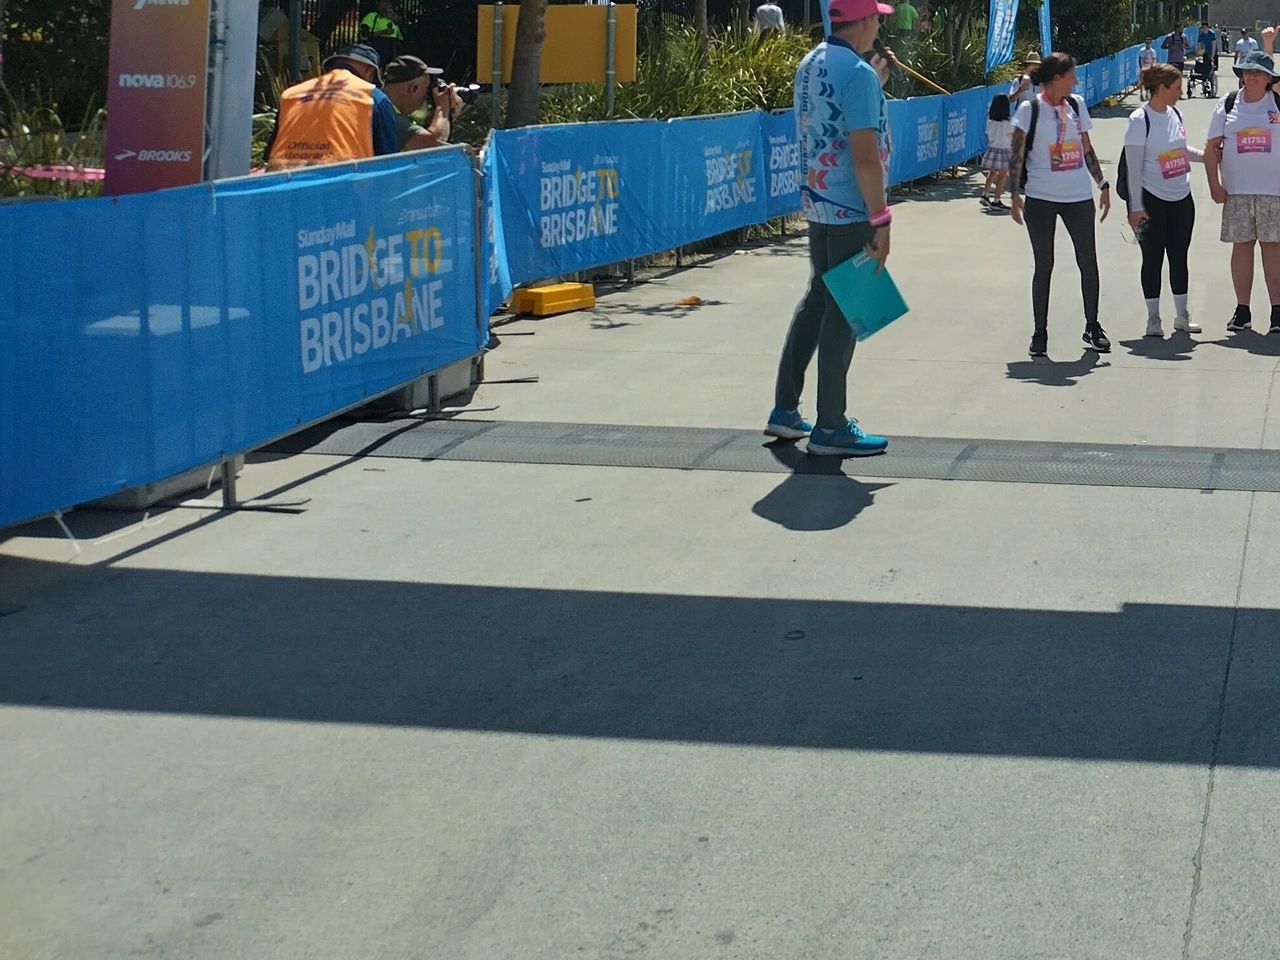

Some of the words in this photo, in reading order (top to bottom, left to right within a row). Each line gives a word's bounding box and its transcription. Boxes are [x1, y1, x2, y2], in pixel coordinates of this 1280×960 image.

[138, 150, 192, 161] BROOKS
[540, 170, 597, 211] BRIDGE
[540, 202, 619, 248] BRISBANE
[298, 234, 404, 312] BRIDGE
[407, 226, 442, 278] TO
[300, 279, 445, 374] BRISBANE
